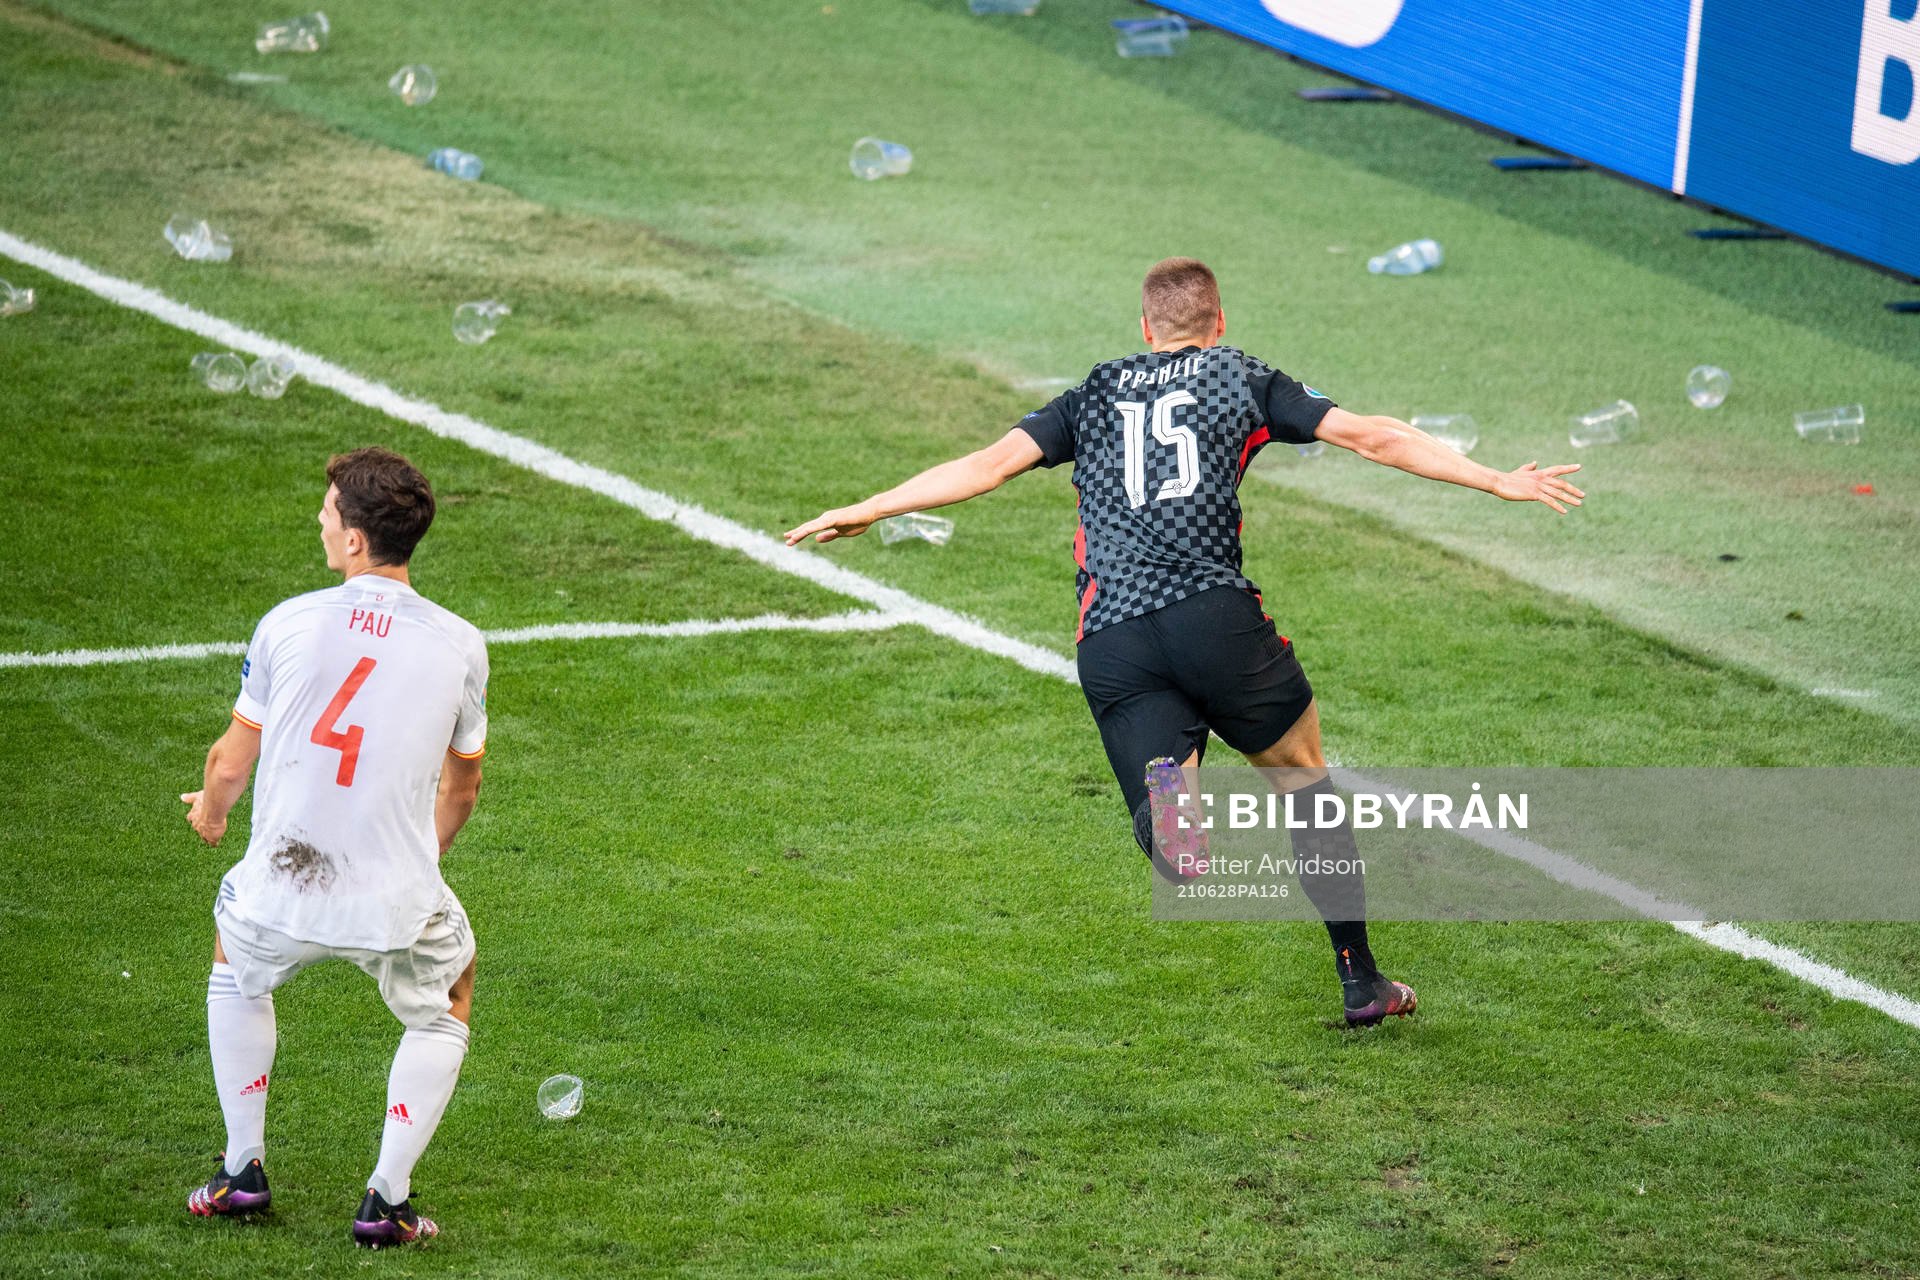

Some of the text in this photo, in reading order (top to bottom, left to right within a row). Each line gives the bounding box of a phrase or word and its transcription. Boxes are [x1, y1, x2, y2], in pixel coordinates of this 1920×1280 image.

[1114, 390, 1200, 509] 15
[349, 608, 392, 638] PAU
[310, 656, 377, 788] 4
